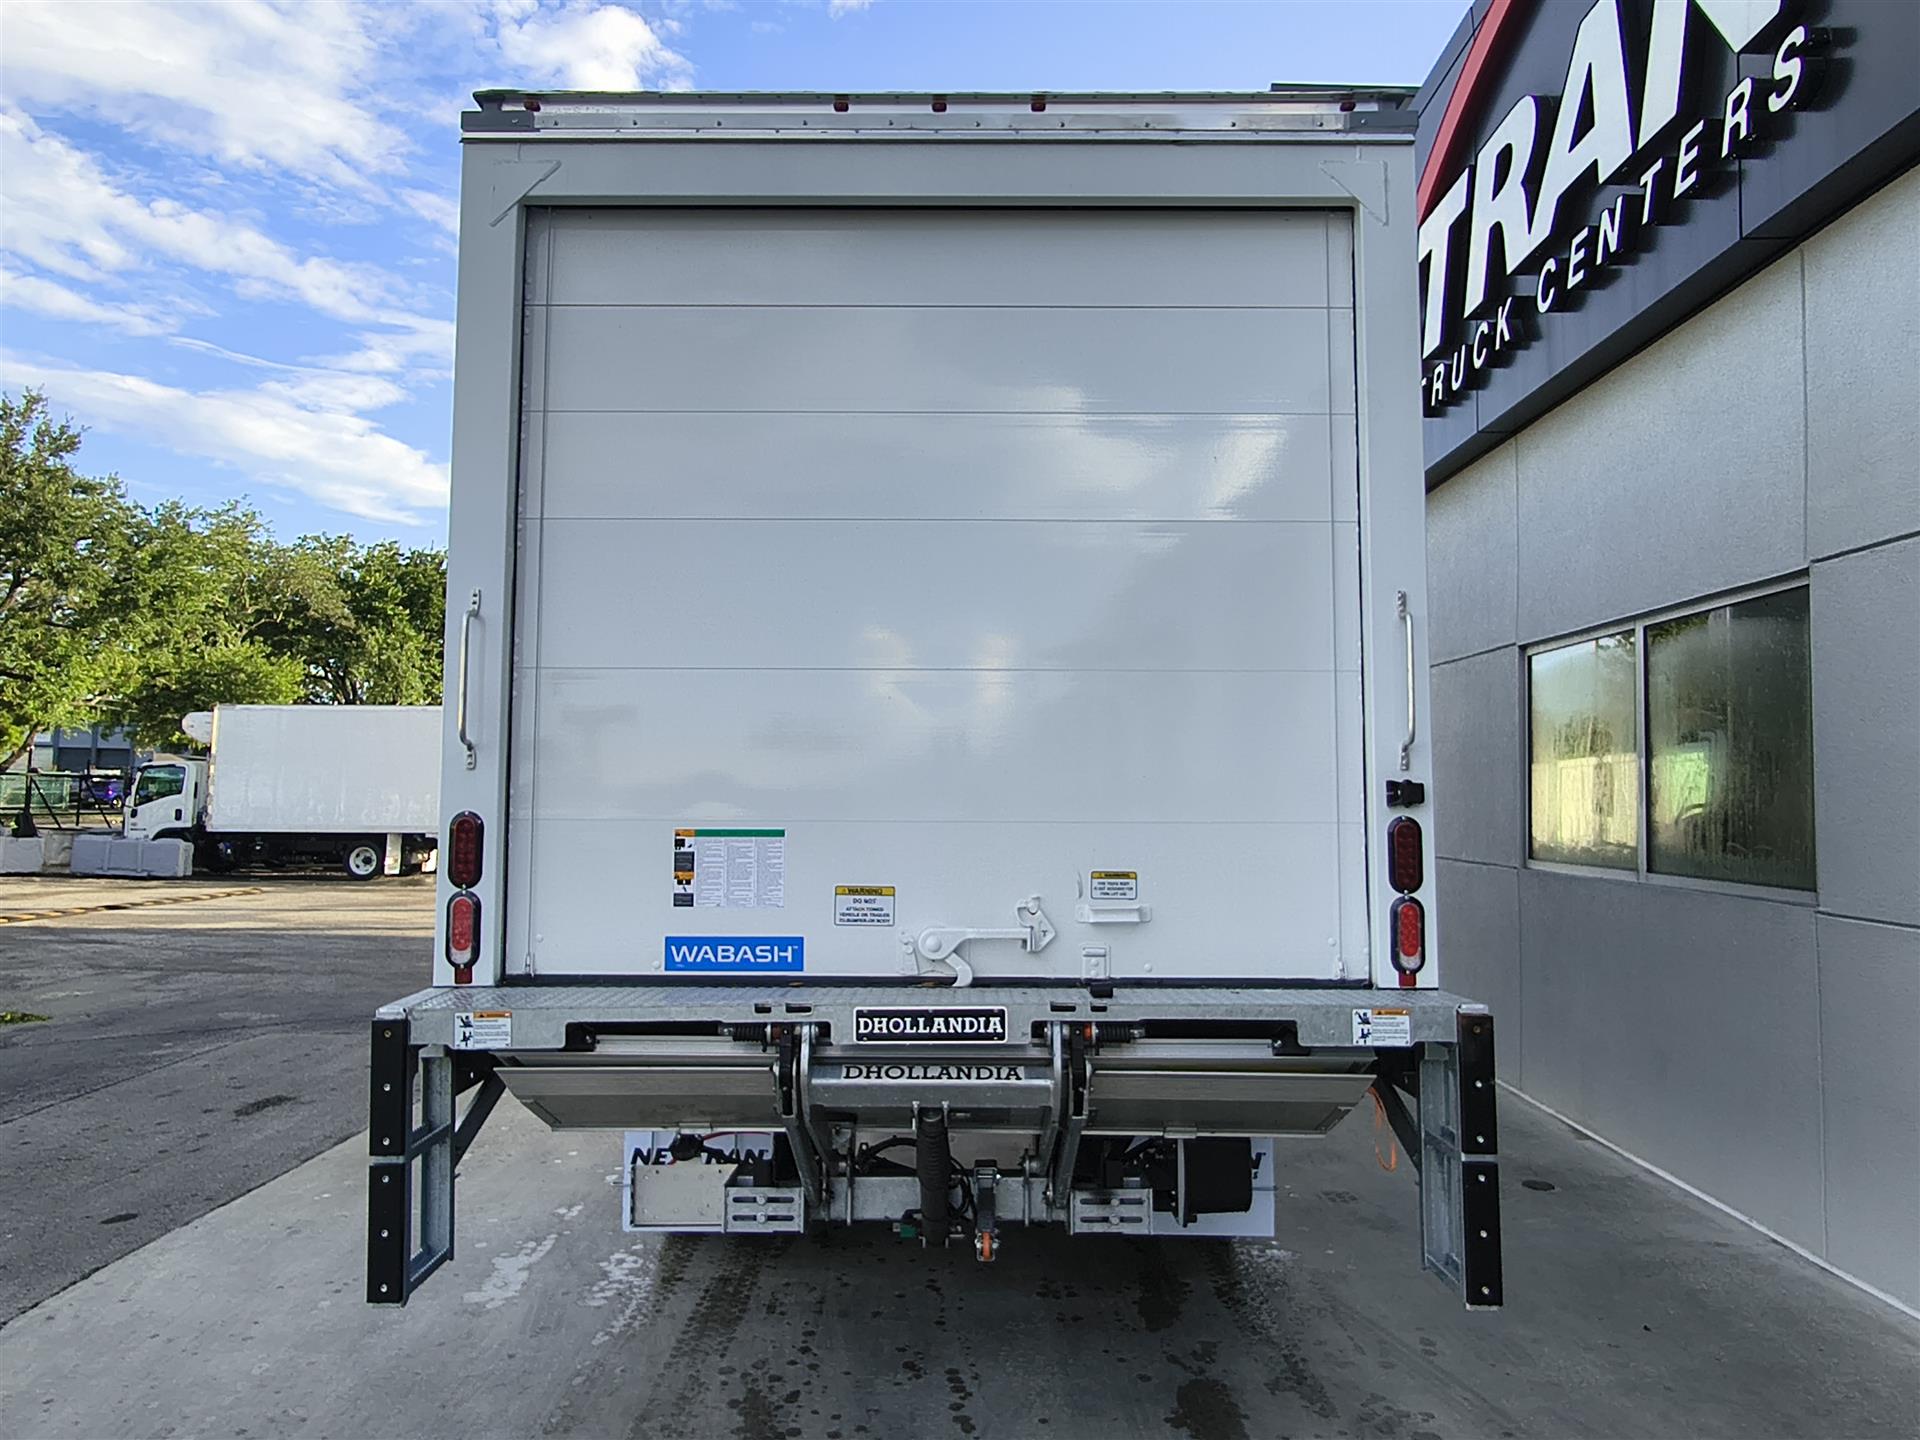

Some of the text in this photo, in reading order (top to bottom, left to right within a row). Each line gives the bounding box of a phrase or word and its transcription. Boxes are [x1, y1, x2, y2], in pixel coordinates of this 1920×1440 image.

[1537, 25, 1806, 314] CENTERS
[858, 1016, 1004, 1034] DHOLLANDIA
[843, 1064, 1023, 1081] DHOLLANDIA
